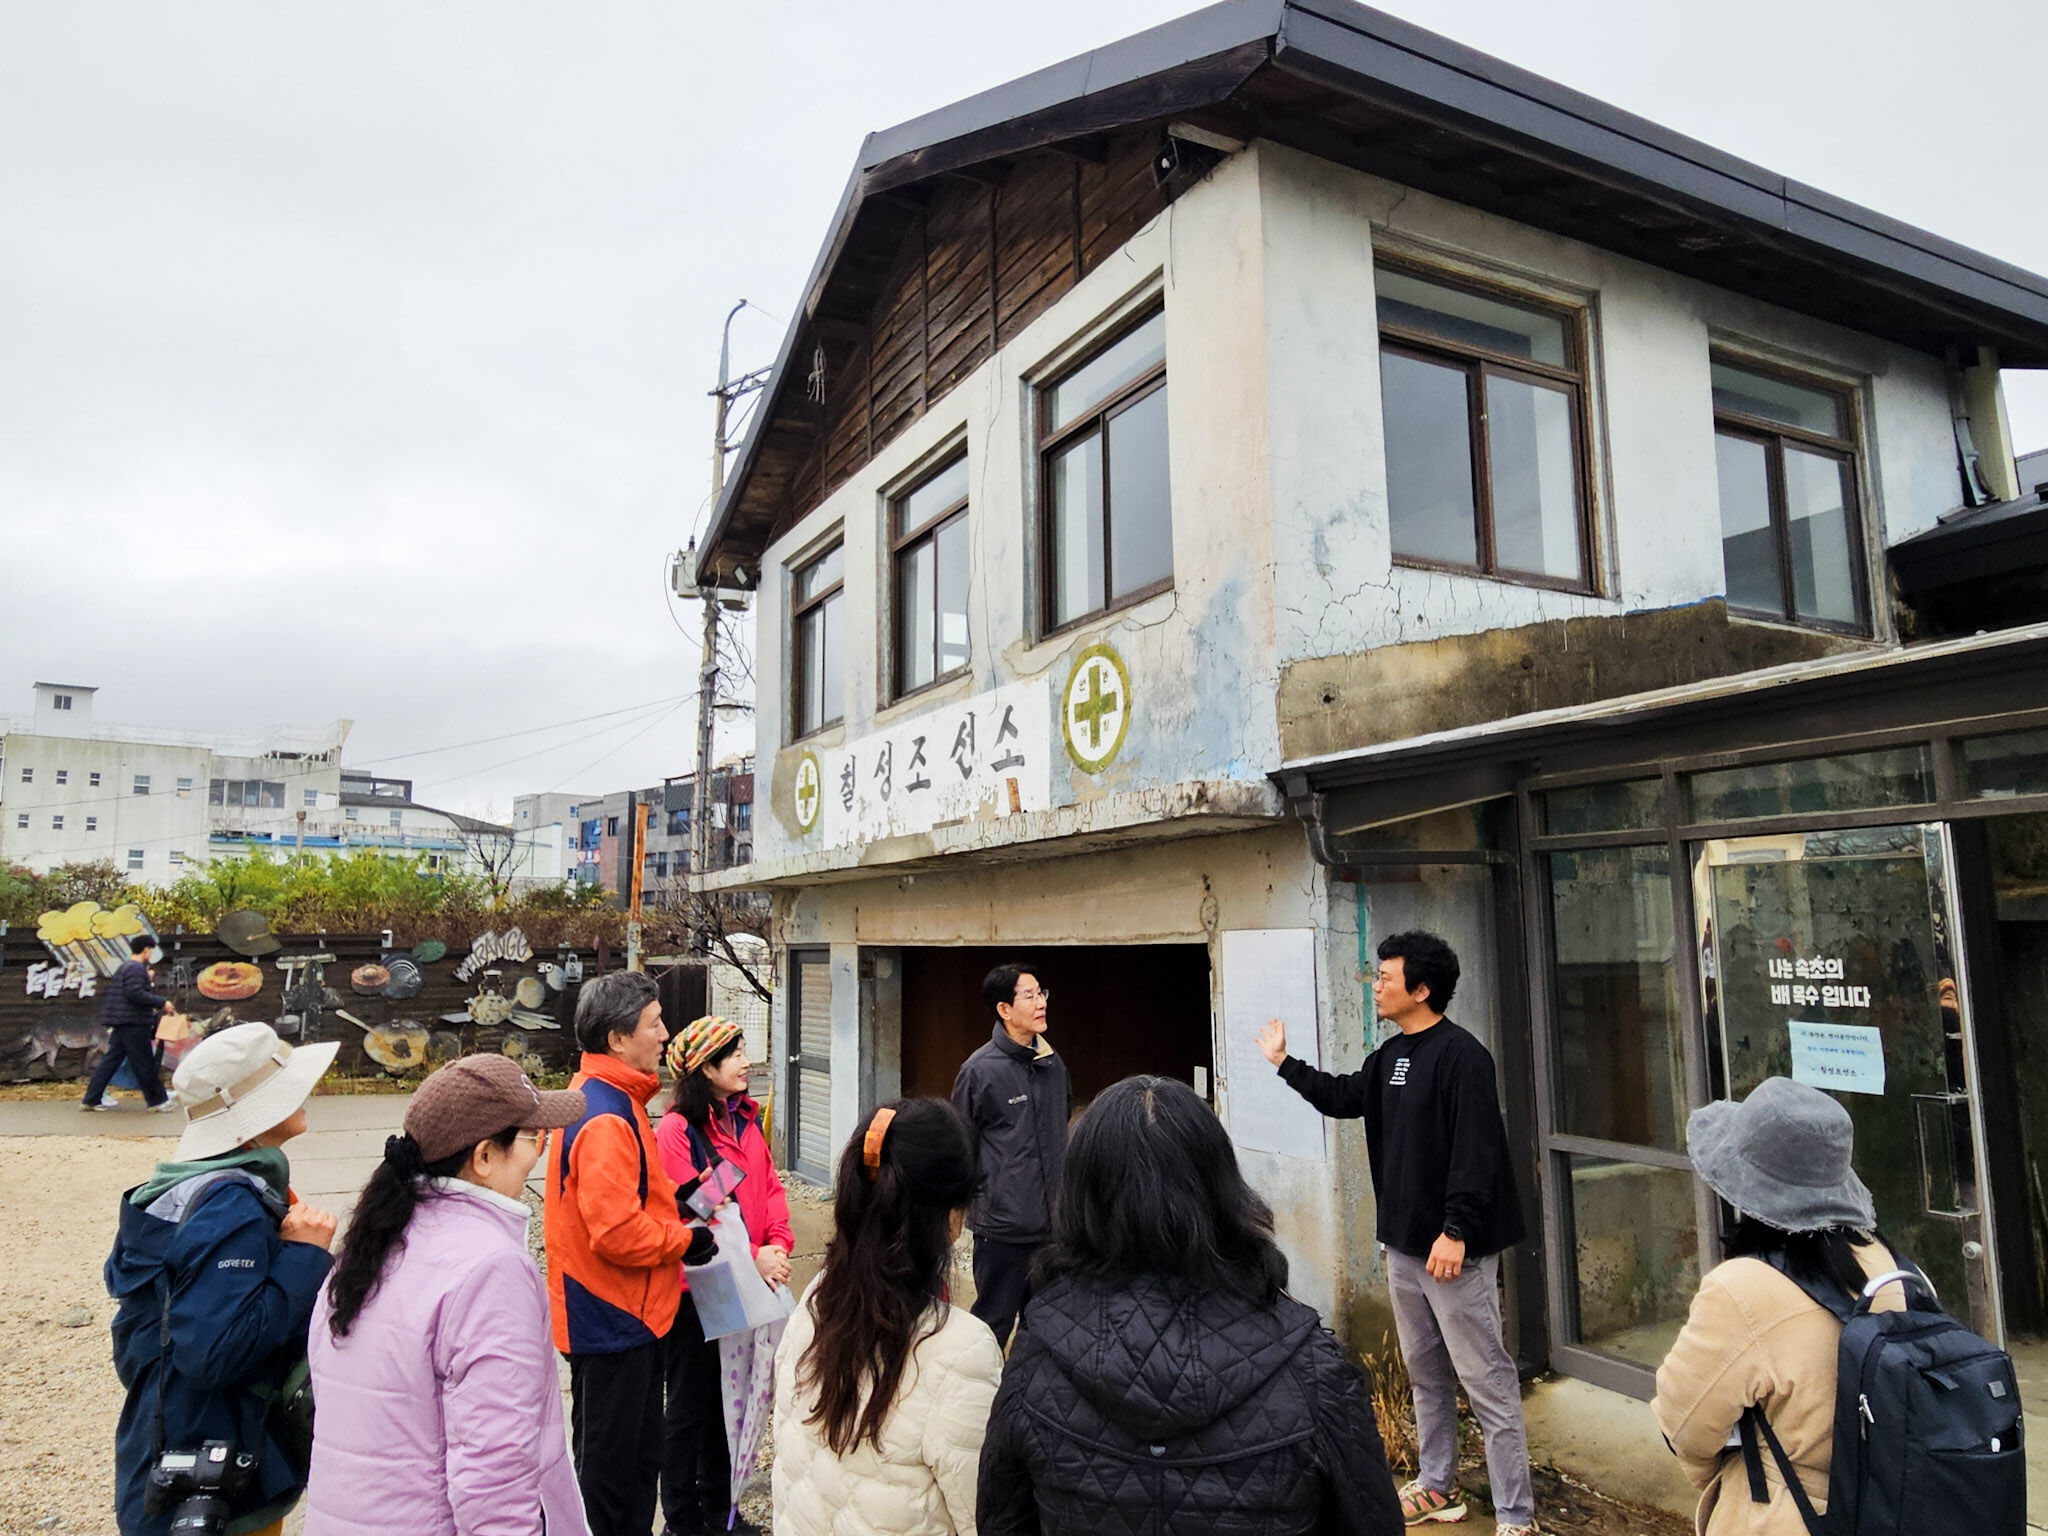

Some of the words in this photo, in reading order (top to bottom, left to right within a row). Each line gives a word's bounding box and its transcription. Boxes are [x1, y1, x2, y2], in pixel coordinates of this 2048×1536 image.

[1768, 958, 1794, 979] 나는
[1796, 954, 1844, 980] 속초의
[1771, 984, 1791, 1005] 배
[217, 1259, 256, 1269] GORE-TEX
